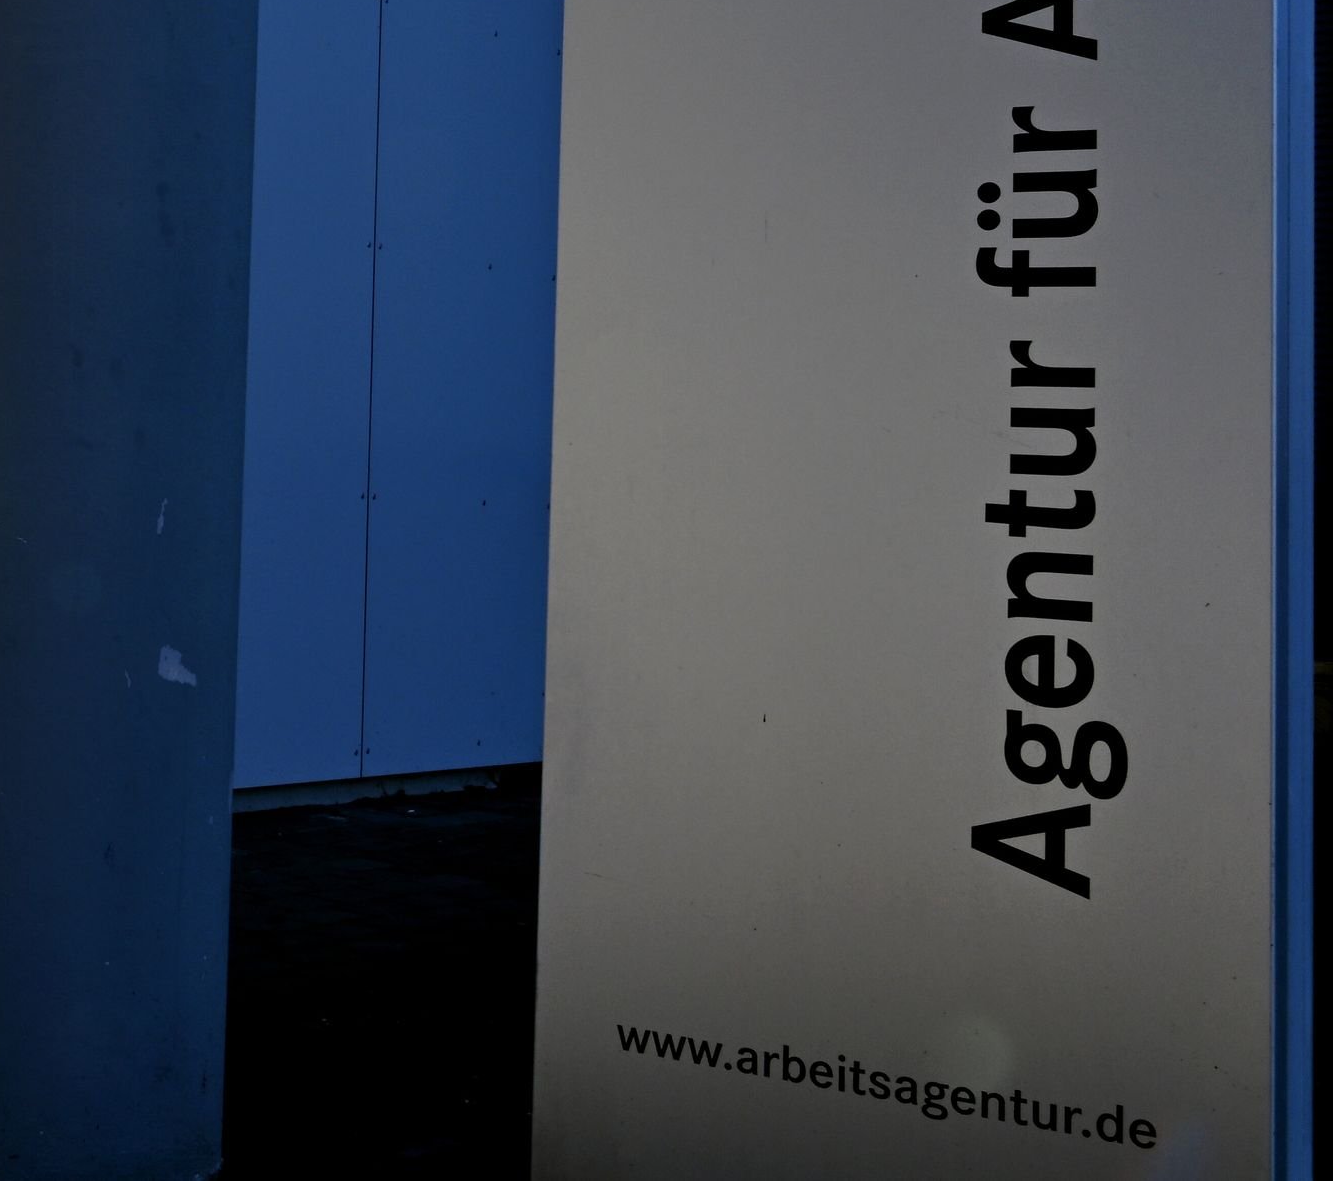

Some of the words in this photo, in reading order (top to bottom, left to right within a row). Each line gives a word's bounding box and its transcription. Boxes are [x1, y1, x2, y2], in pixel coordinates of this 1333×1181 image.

[975, 105, 1099, 298] für
[970, 340, 1129, 900] Agentur
[616, 1024, 1158, 1150] www.arbeitsagentur.de
